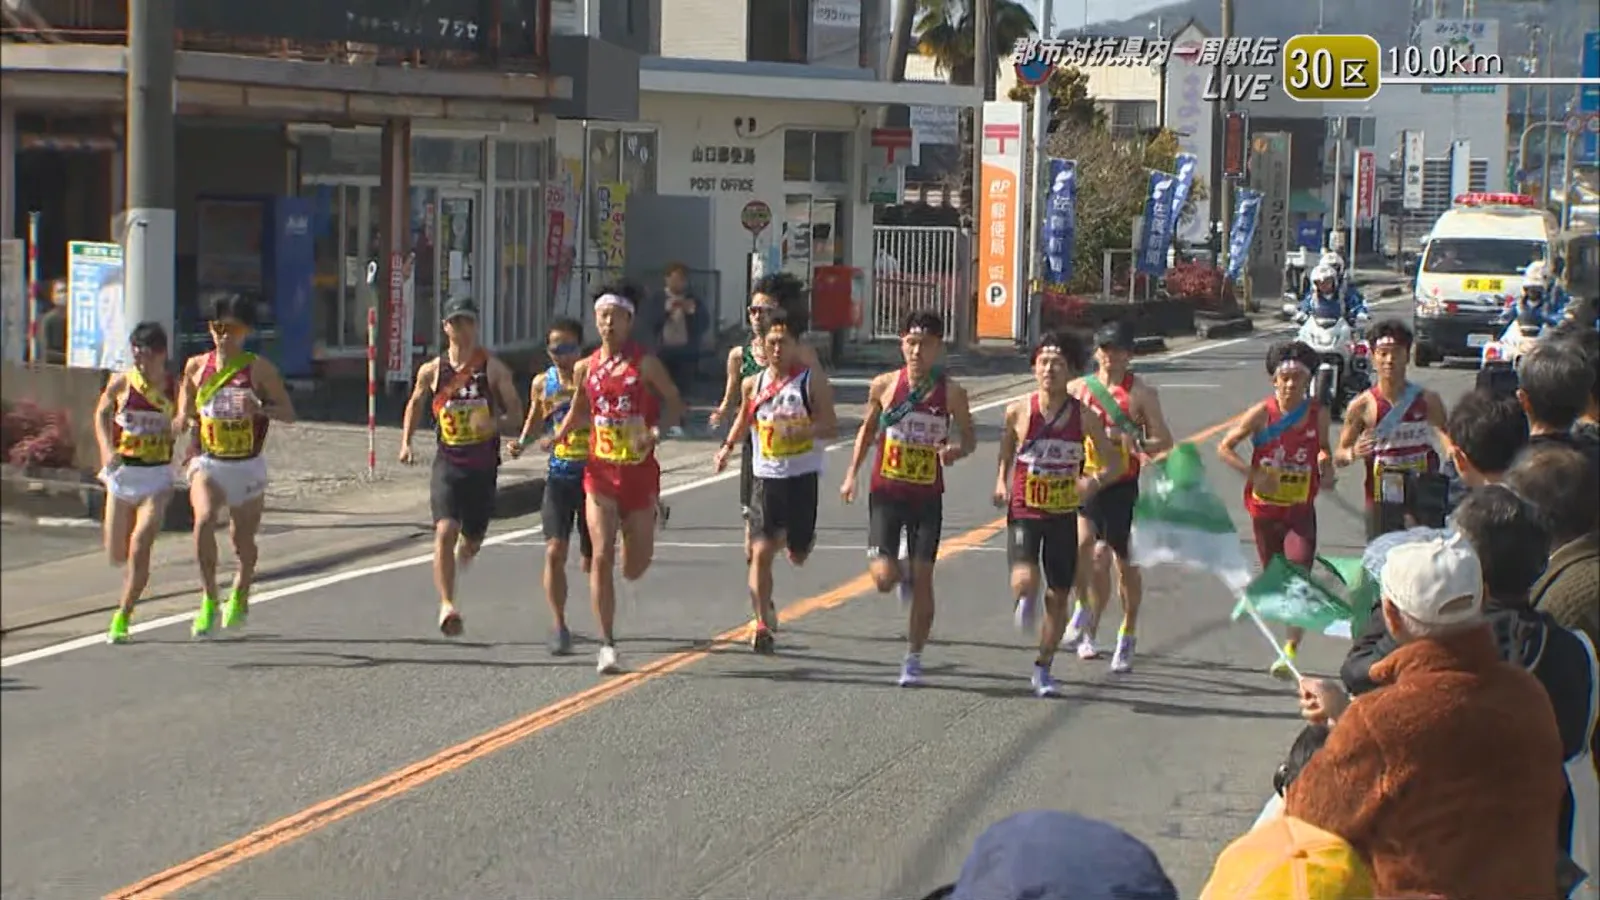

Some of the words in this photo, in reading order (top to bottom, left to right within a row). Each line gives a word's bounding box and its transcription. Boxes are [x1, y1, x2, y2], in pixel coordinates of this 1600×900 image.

[690, 178, 716, 191] POST
[721, 178, 754, 192] OFFICE
[990, 203, 1006, 256] 郵便局
[990, 286, 1001, 302] P
[600, 427, 614, 453] 5
[763, 427, 774, 448] 7
[887, 444, 902, 468] 8
[1030, 478, 1048, 505] 10
